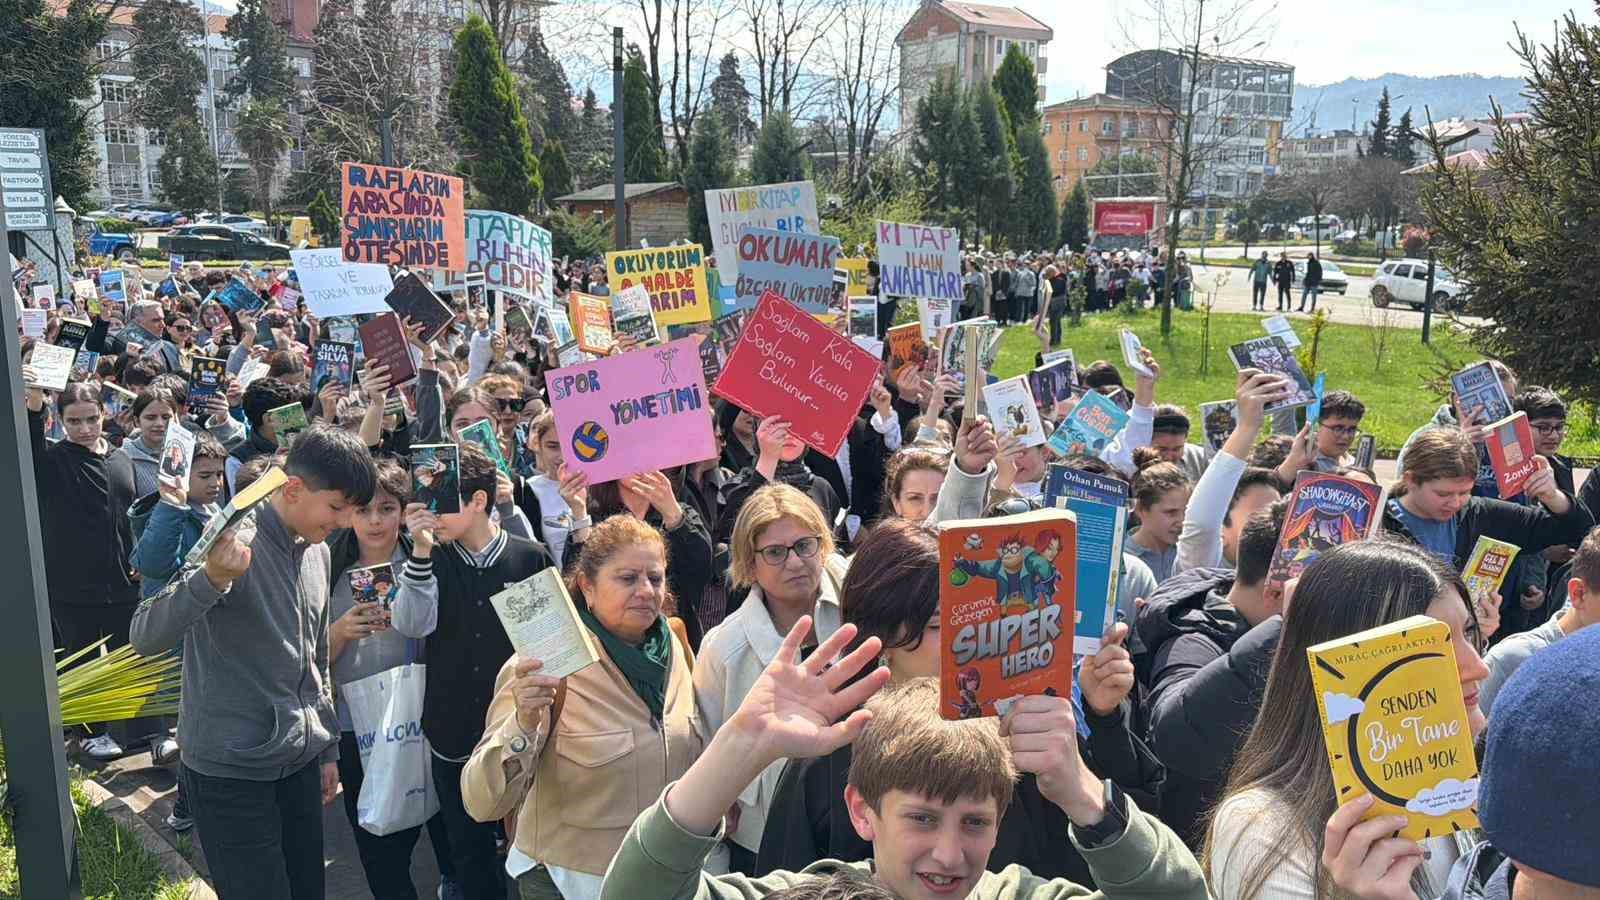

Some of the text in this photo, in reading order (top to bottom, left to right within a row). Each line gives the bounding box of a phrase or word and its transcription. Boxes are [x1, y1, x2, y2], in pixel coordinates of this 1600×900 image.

[349, 166, 450, 199] RAFLARIN
[347, 190, 446, 218] ARASINDA
[615, 248, 701, 275] OKUYORUM
[738, 233, 835, 270] OKUMAK
[650, 288, 697, 312] ARIM
[316, 352, 349, 363] SILVA
[319, 343, 348, 353] RAFA
[551, 369, 601, 401] SPOR
[609, 383, 702, 426] YÖNETİMİ
[1063, 471, 1091, 487] Orhan
[1093, 478, 1124, 494] Pamuk
[1299, 486, 1369, 512] SHADOWGHAST
[951, 603, 1062, 668] SUPER
[1001, 642, 1055, 680] HERO
[1380, 687, 1438, 716] SENDEN
[1365, 716, 1461, 763] Bin Tane
[1382, 749, 1459, 781] DAHA YOK
